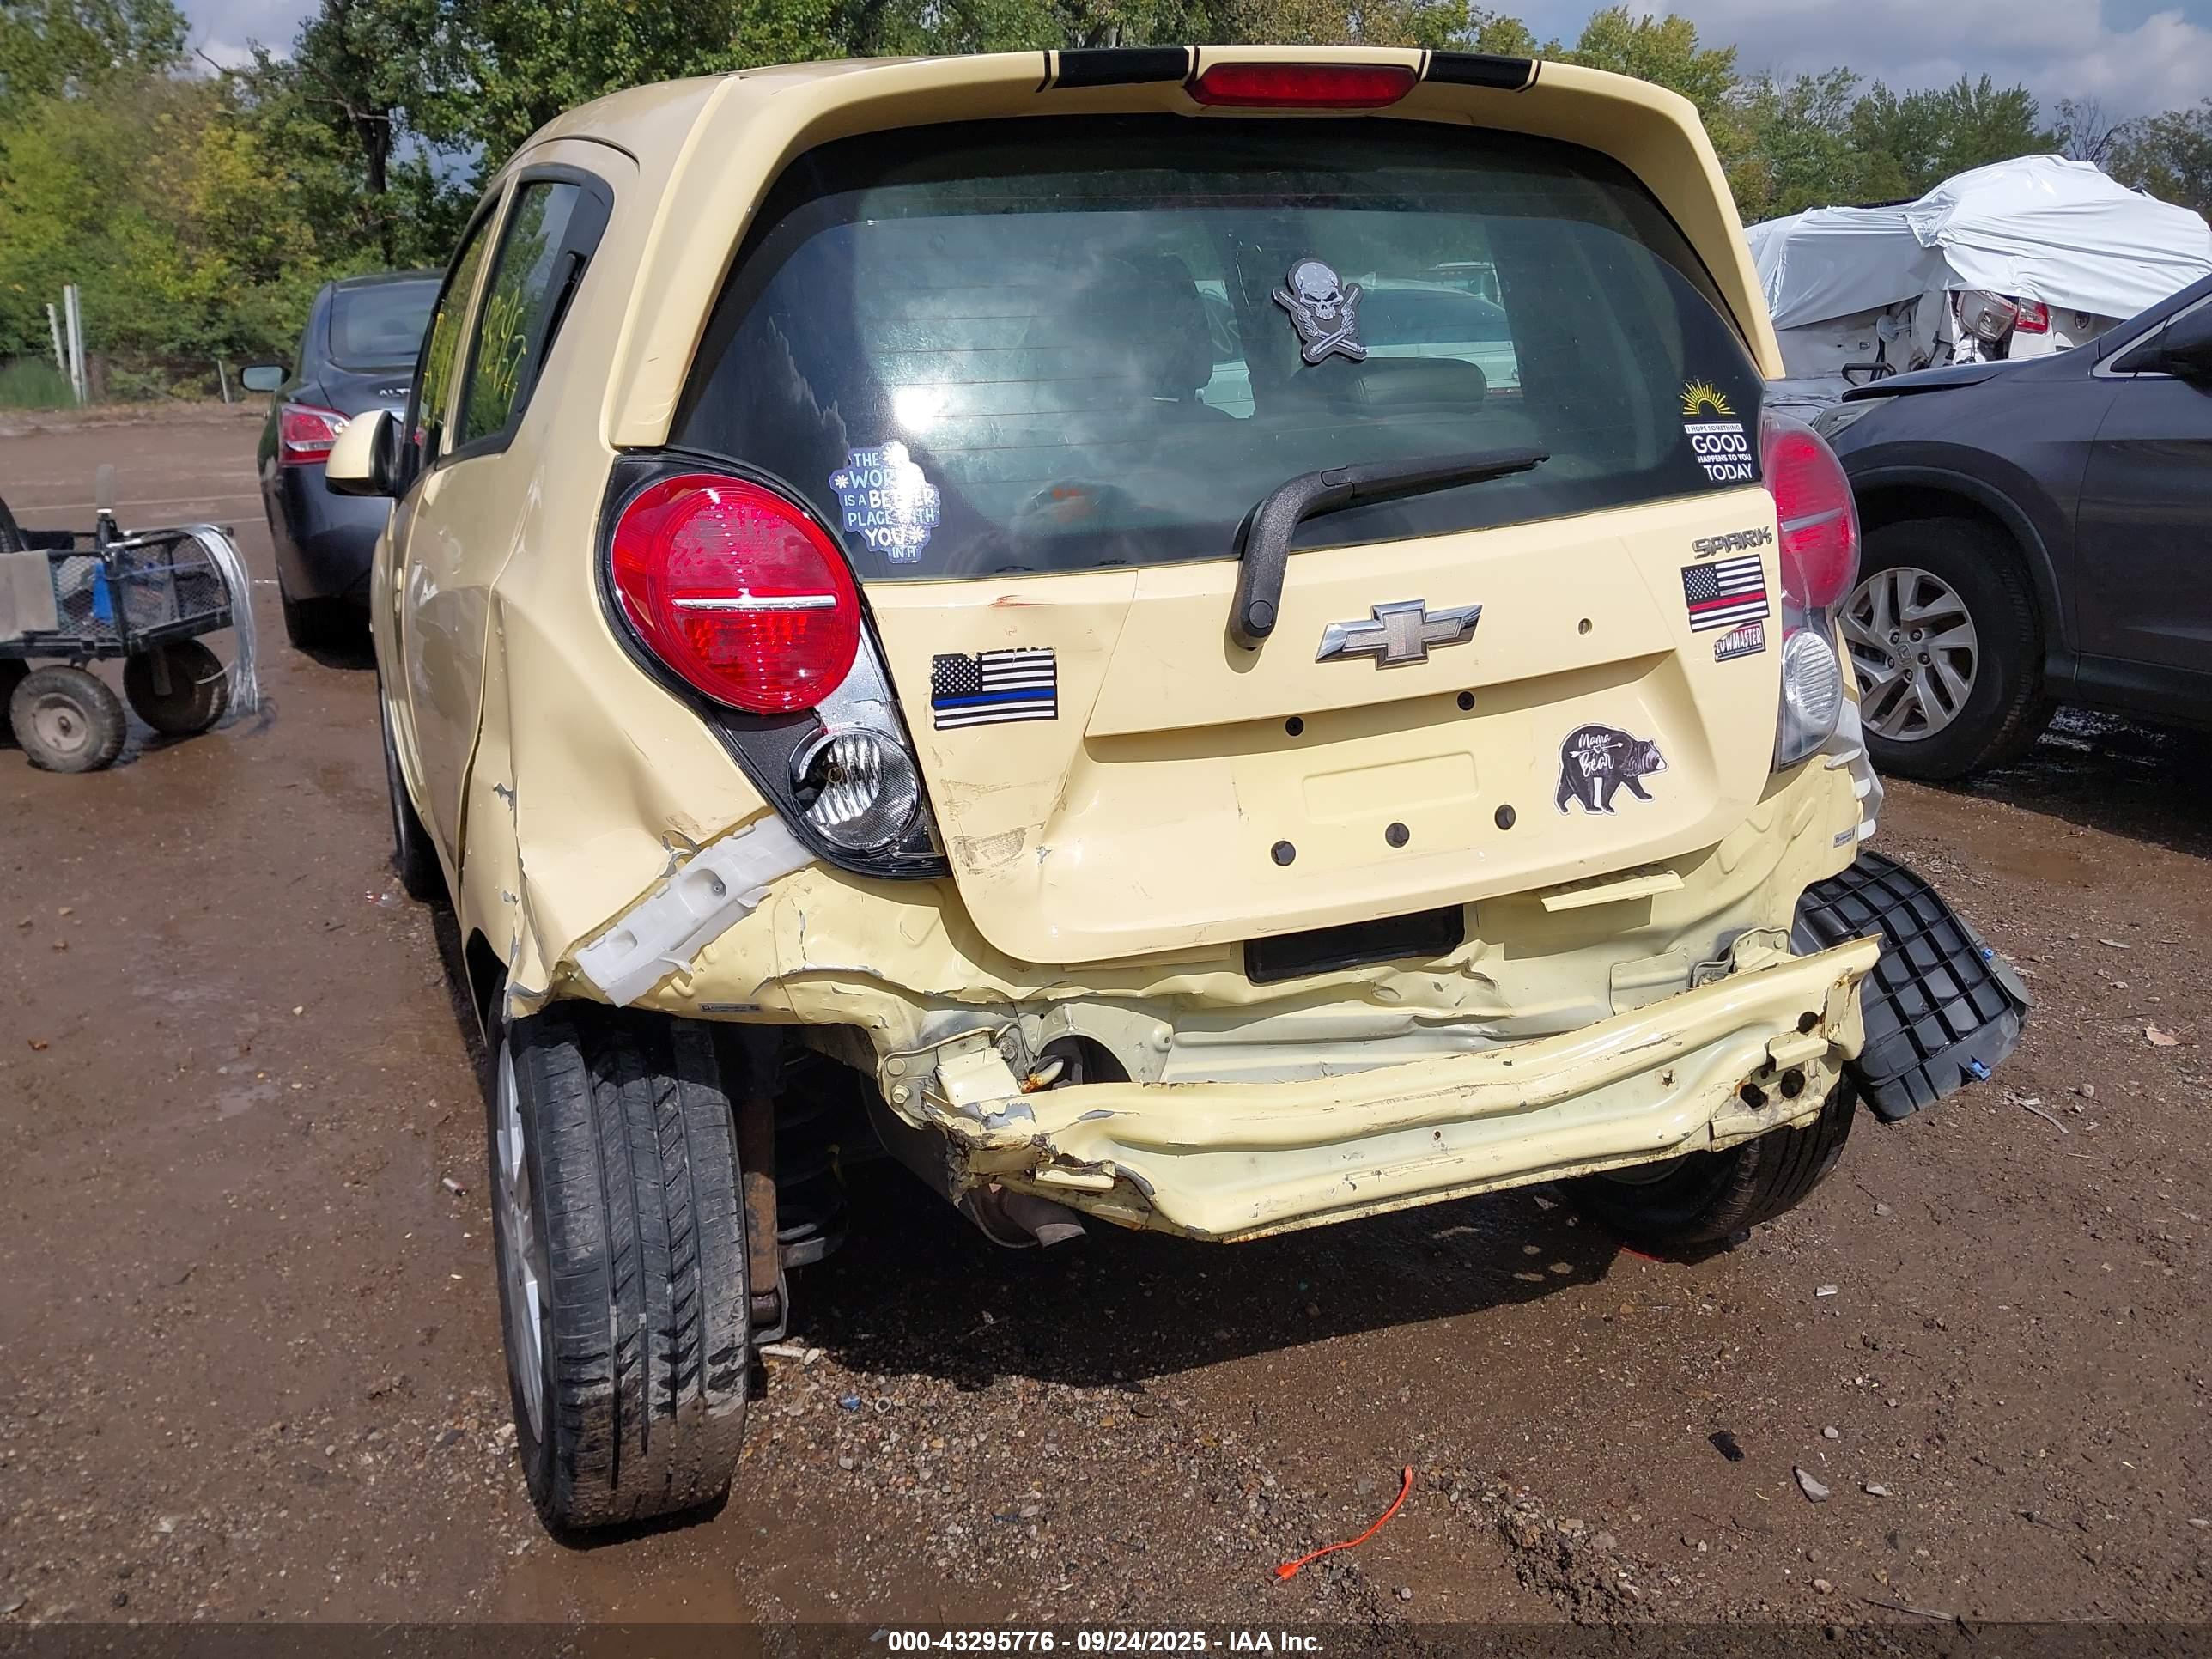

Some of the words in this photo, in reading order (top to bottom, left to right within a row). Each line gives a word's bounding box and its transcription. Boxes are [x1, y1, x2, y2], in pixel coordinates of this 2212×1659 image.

[1692, 434, 1747, 453] GOOD
[854, 453, 880, 467] THE
[1697, 454, 1728, 463] HAPPENS
[1703, 463, 1753, 481] TODAY
[844, 495, 855, 506] IS
[858, 494, 866, 506] A
[868, 488, 935, 508] BEER
[848, 510, 893, 526] PLACE
[865, 527, 906, 546] YOU
[1692, 526, 1772, 560] SPARK
[892, 547, 904, 558] IN
[907, 545, 916, 557] IT
[1578, 733, 1611, 748] Mama
[1579, 752, 1614, 777] Bear
